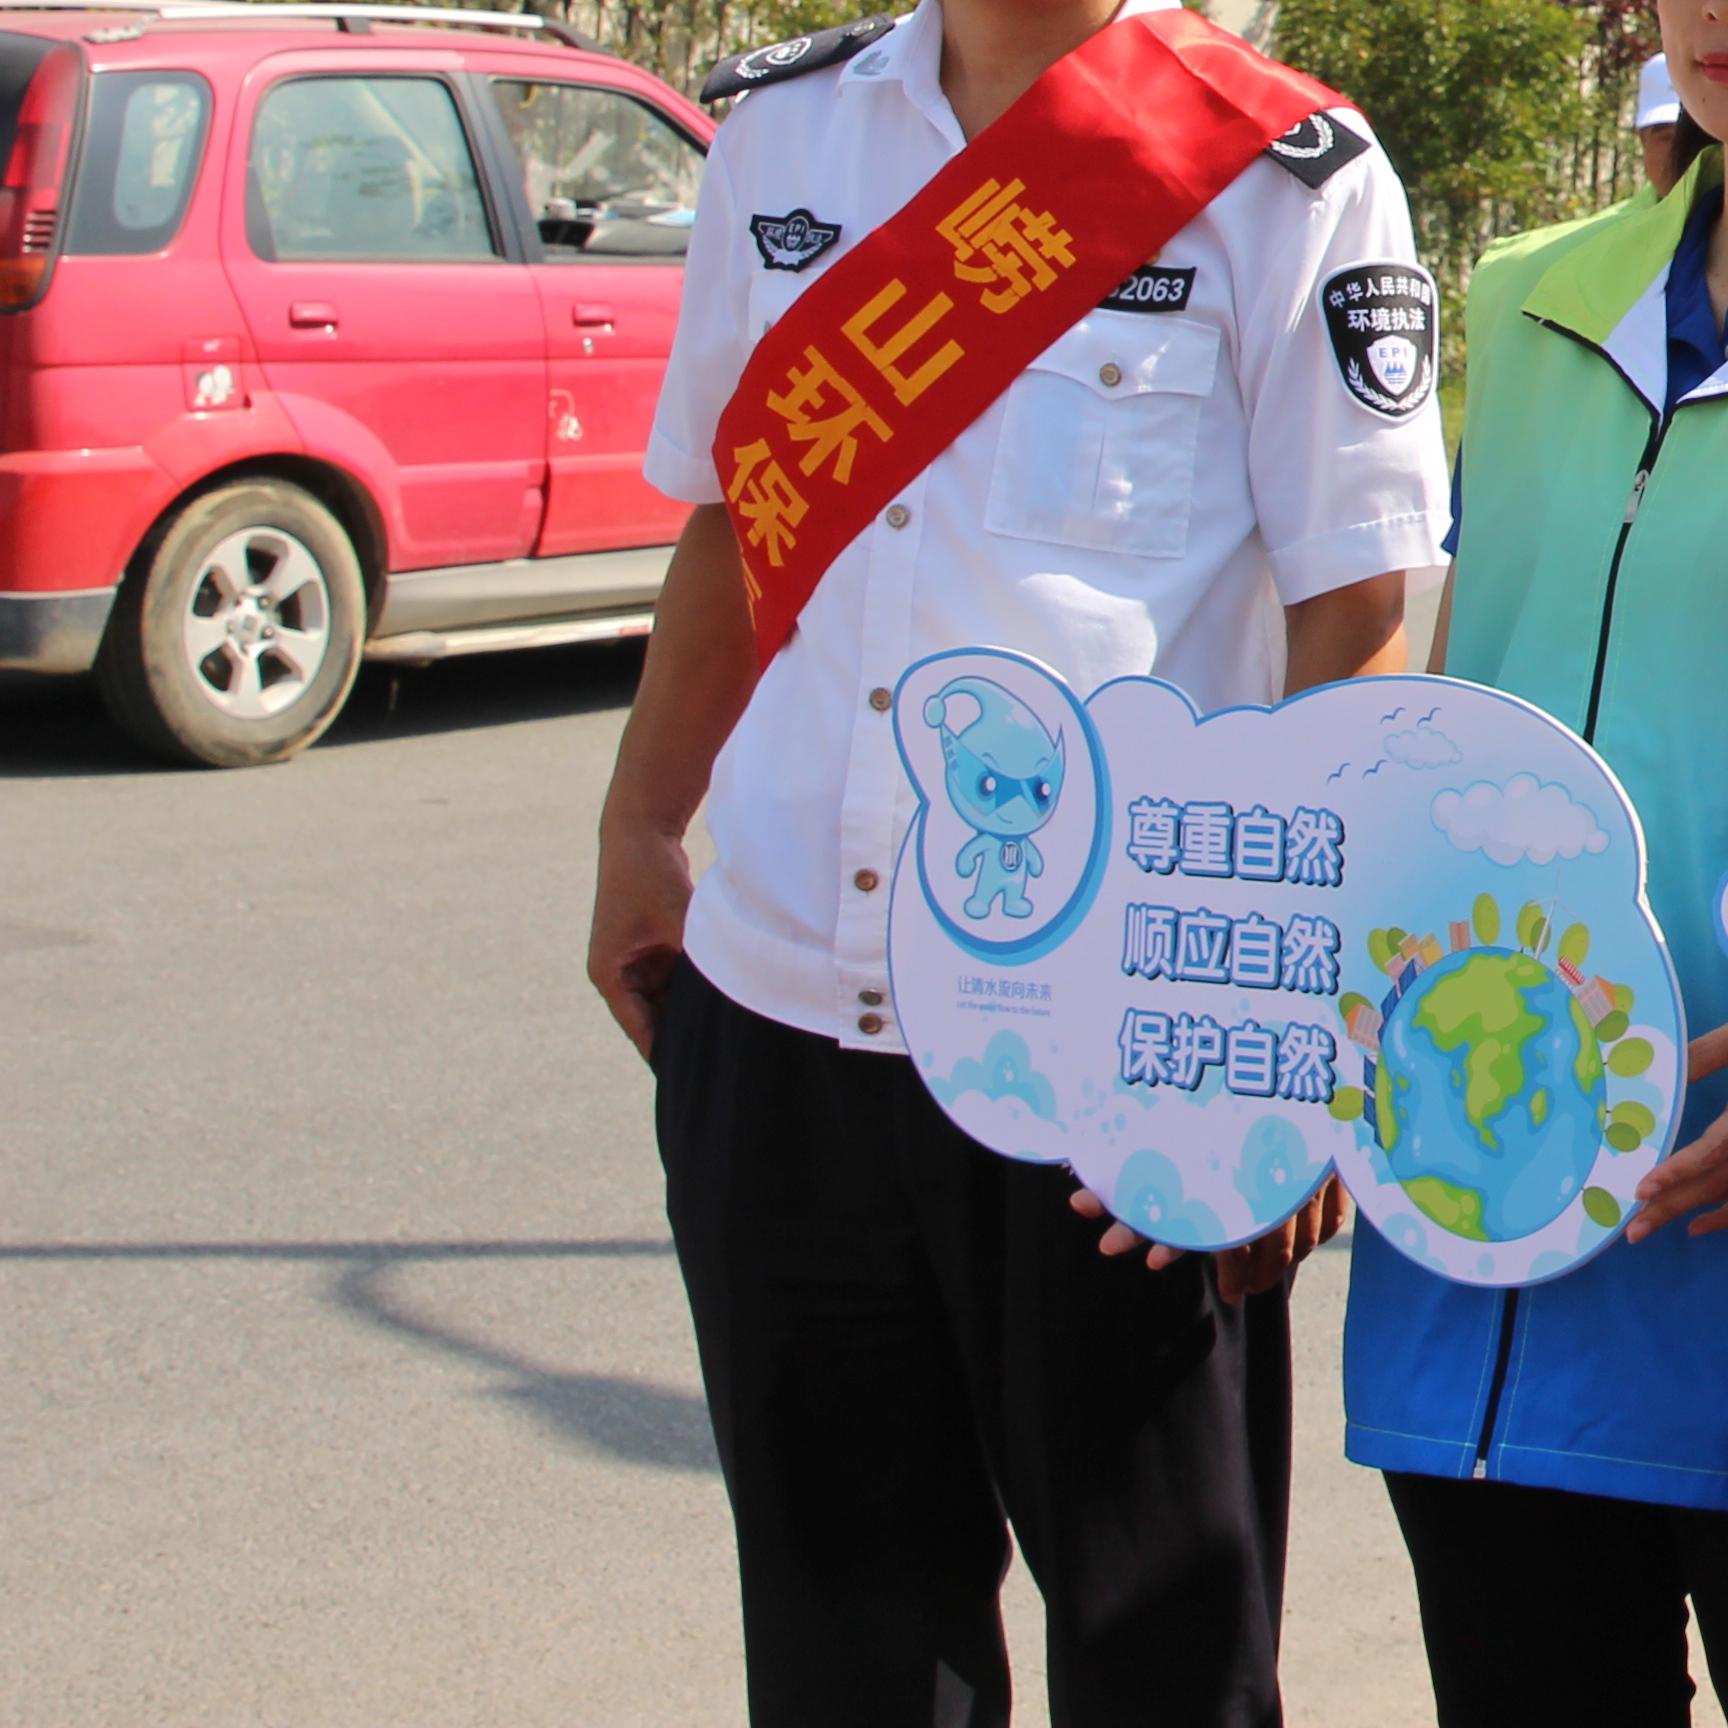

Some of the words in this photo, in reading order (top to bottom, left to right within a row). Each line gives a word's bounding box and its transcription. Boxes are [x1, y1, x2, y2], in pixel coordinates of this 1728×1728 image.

[1107, 276, 1185, 302] 2063
[1329, 276, 1432, 308] 中华人民共和国
[1347, 307, 1427, 333] 环境执法
[1378, 347, 1408, 359] EPI
[727, 178, 1077, 622] 崂山环保
[1127, 796, 1345, 887] 尊重自然
[1121, 903, 1341, 996] 顺应自然
[958, 975, 1053, 1002] 让清水流向未来
[1118, 1008, 1337, 1104] 保护自然
